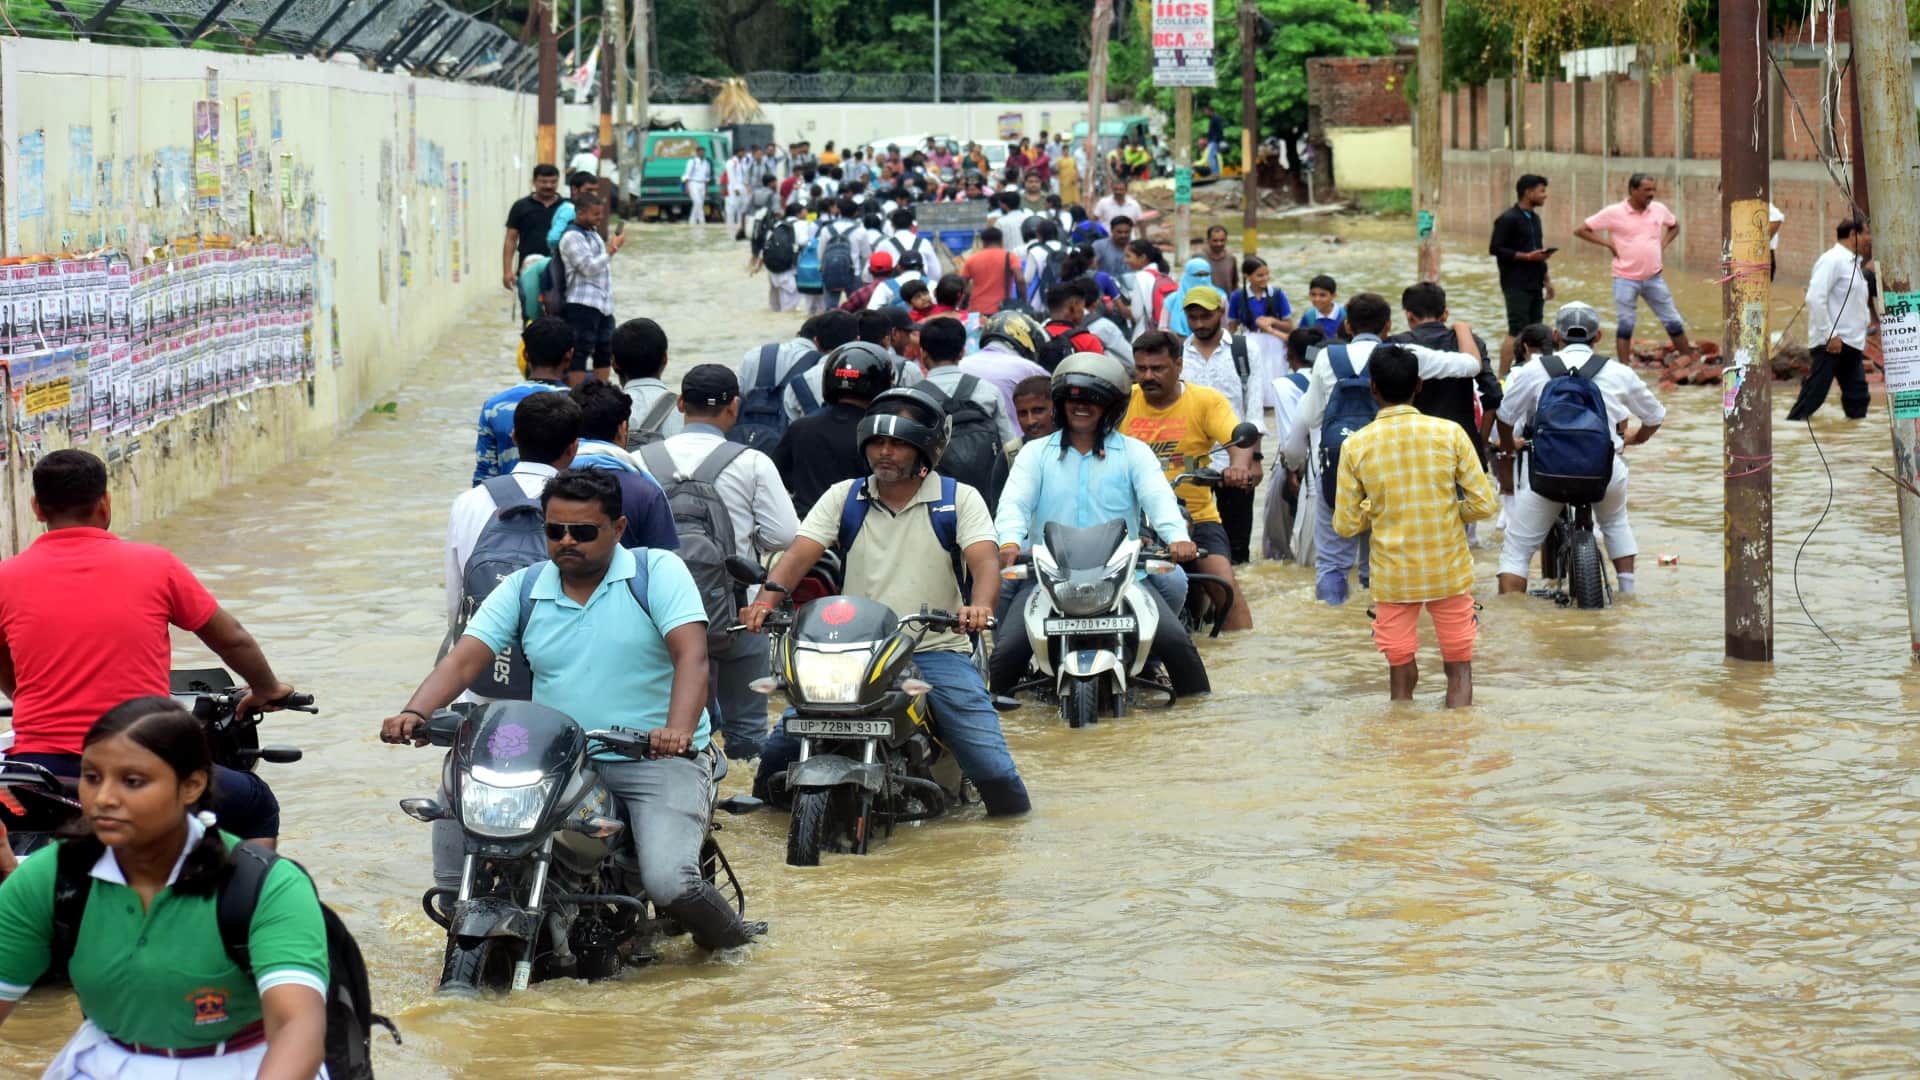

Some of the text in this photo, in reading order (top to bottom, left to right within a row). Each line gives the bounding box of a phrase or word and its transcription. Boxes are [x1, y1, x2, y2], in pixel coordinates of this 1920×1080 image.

[1153, 32, 1185, 47] BCA
[800, 721, 888, 734] UP 72BN 9317
